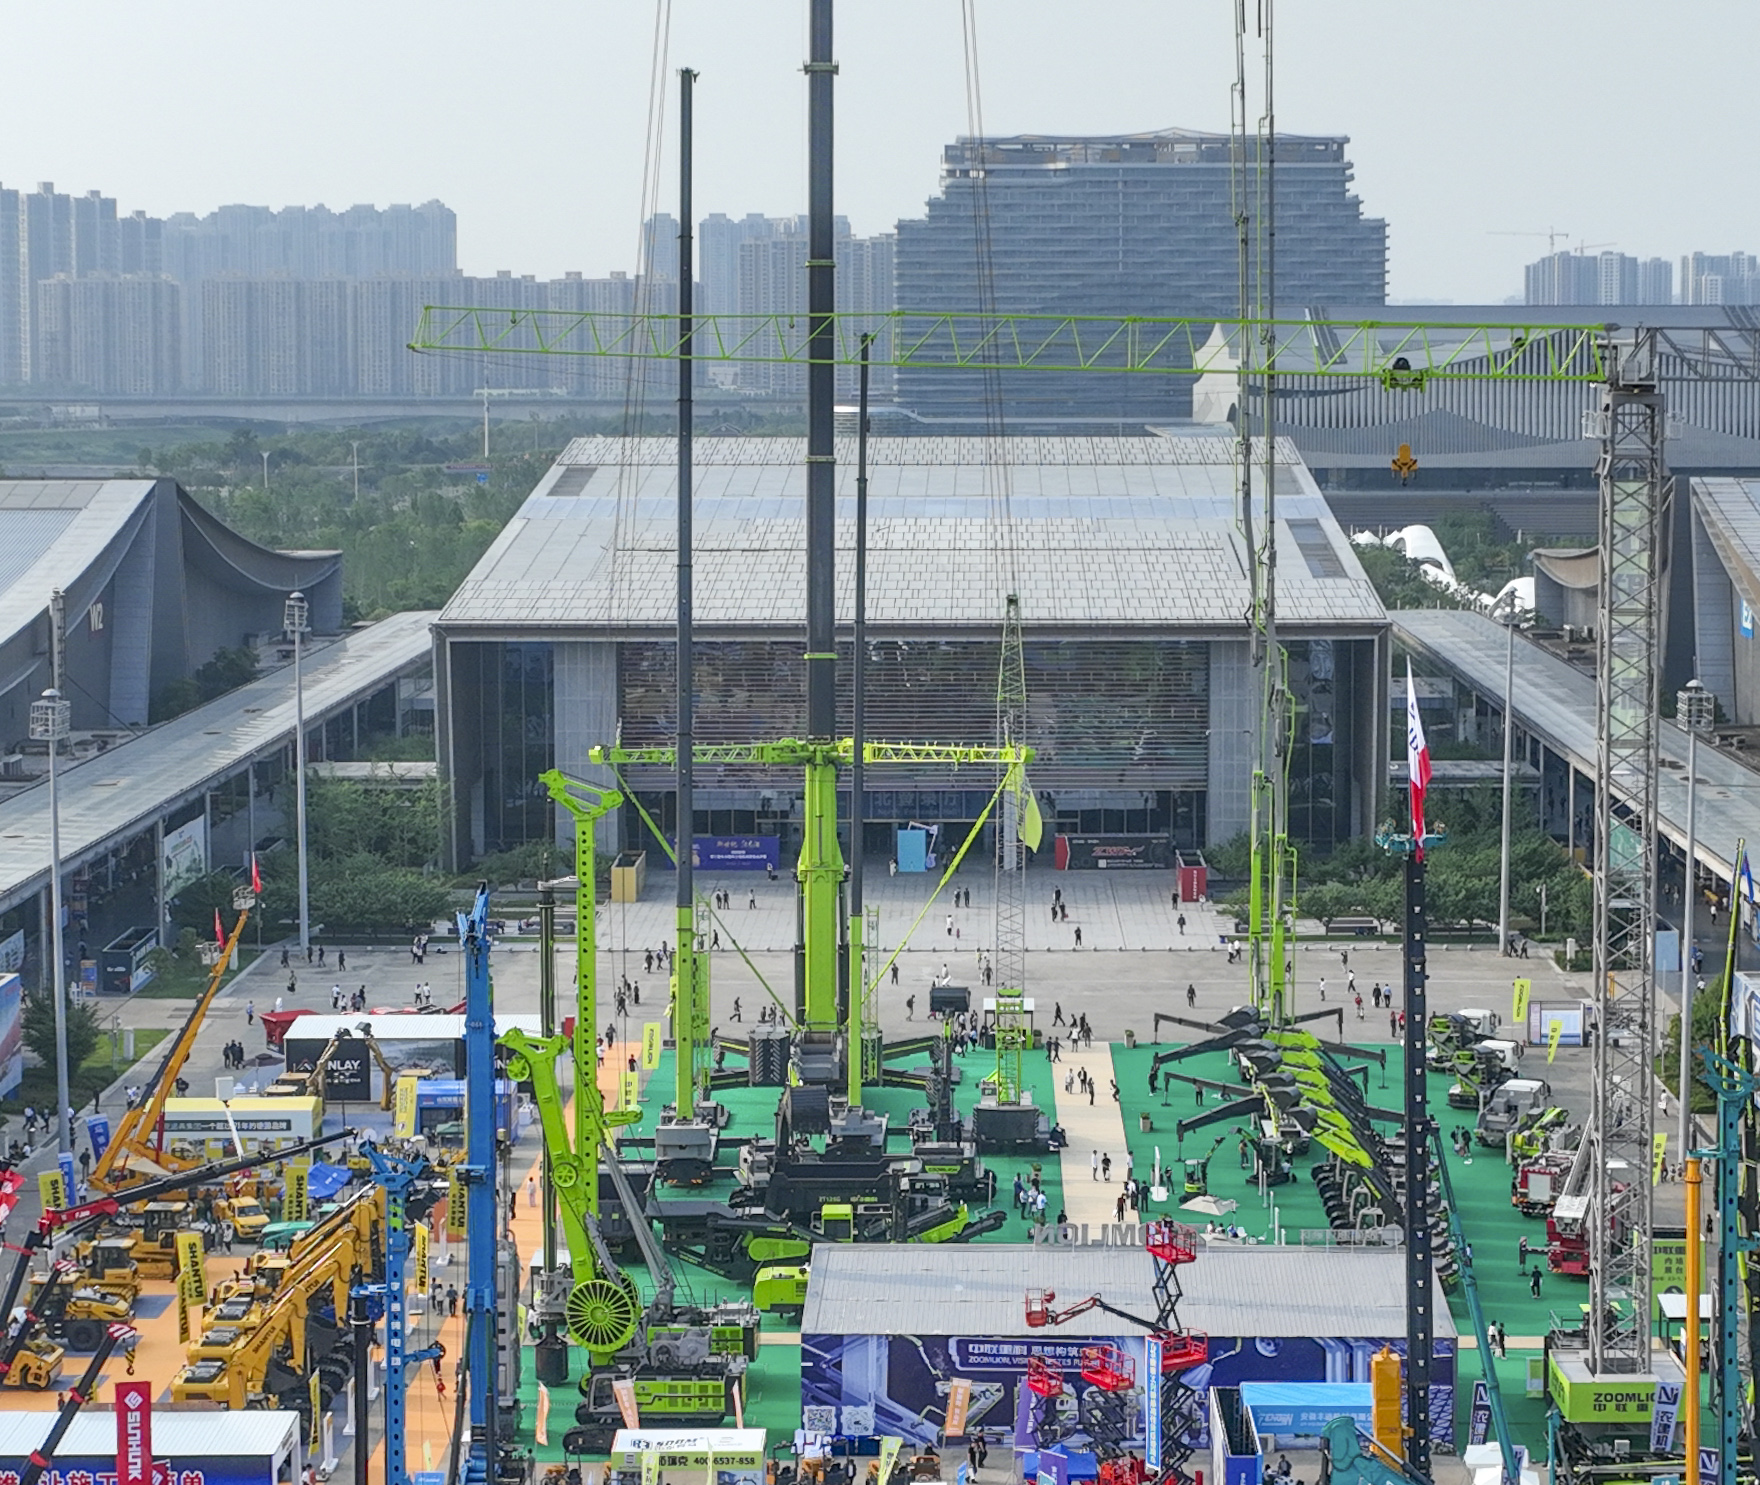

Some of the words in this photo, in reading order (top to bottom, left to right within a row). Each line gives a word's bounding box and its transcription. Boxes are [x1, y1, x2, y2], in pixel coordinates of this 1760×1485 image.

[189, 1242, 205, 1299] SHANTUI
[1594, 1392, 1656, 1403] ZOOMLI
[1594, 1404, 1649, 1413] 中联重
[126, 1411, 142, 1482] SUNHUNK
[693, 1456, 756, 1465] 4006537-858
